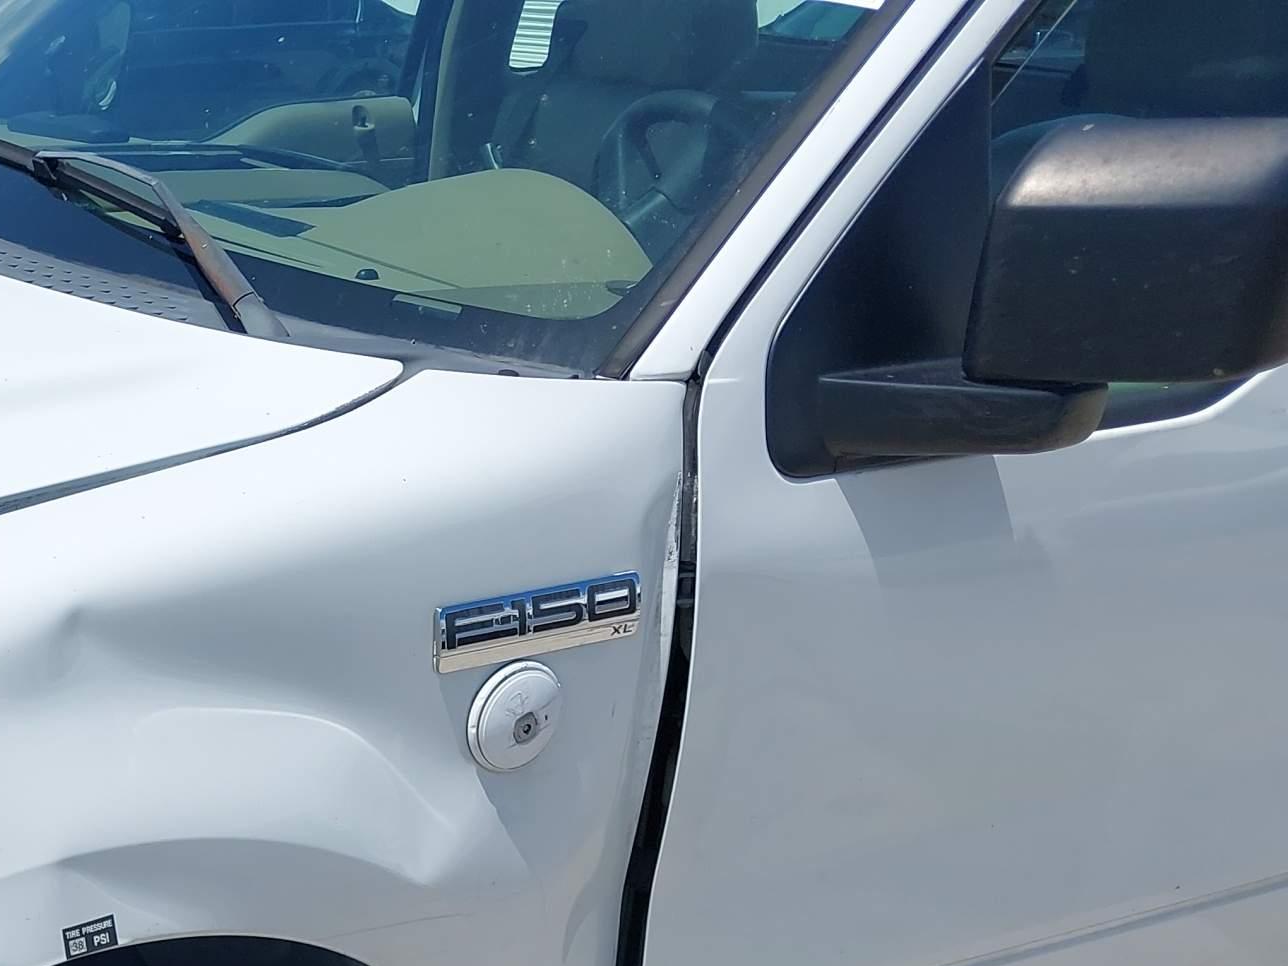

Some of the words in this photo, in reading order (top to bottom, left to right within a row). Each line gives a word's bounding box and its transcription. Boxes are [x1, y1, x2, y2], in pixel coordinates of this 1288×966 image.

[611, 624, 633, 637] XL
[65, 929, 81, 939] TIRE
[82, 920, 113, 935] PRESSURE
[72, 940, 84, 952] 38
[93, 932, 110, 946] PSI
